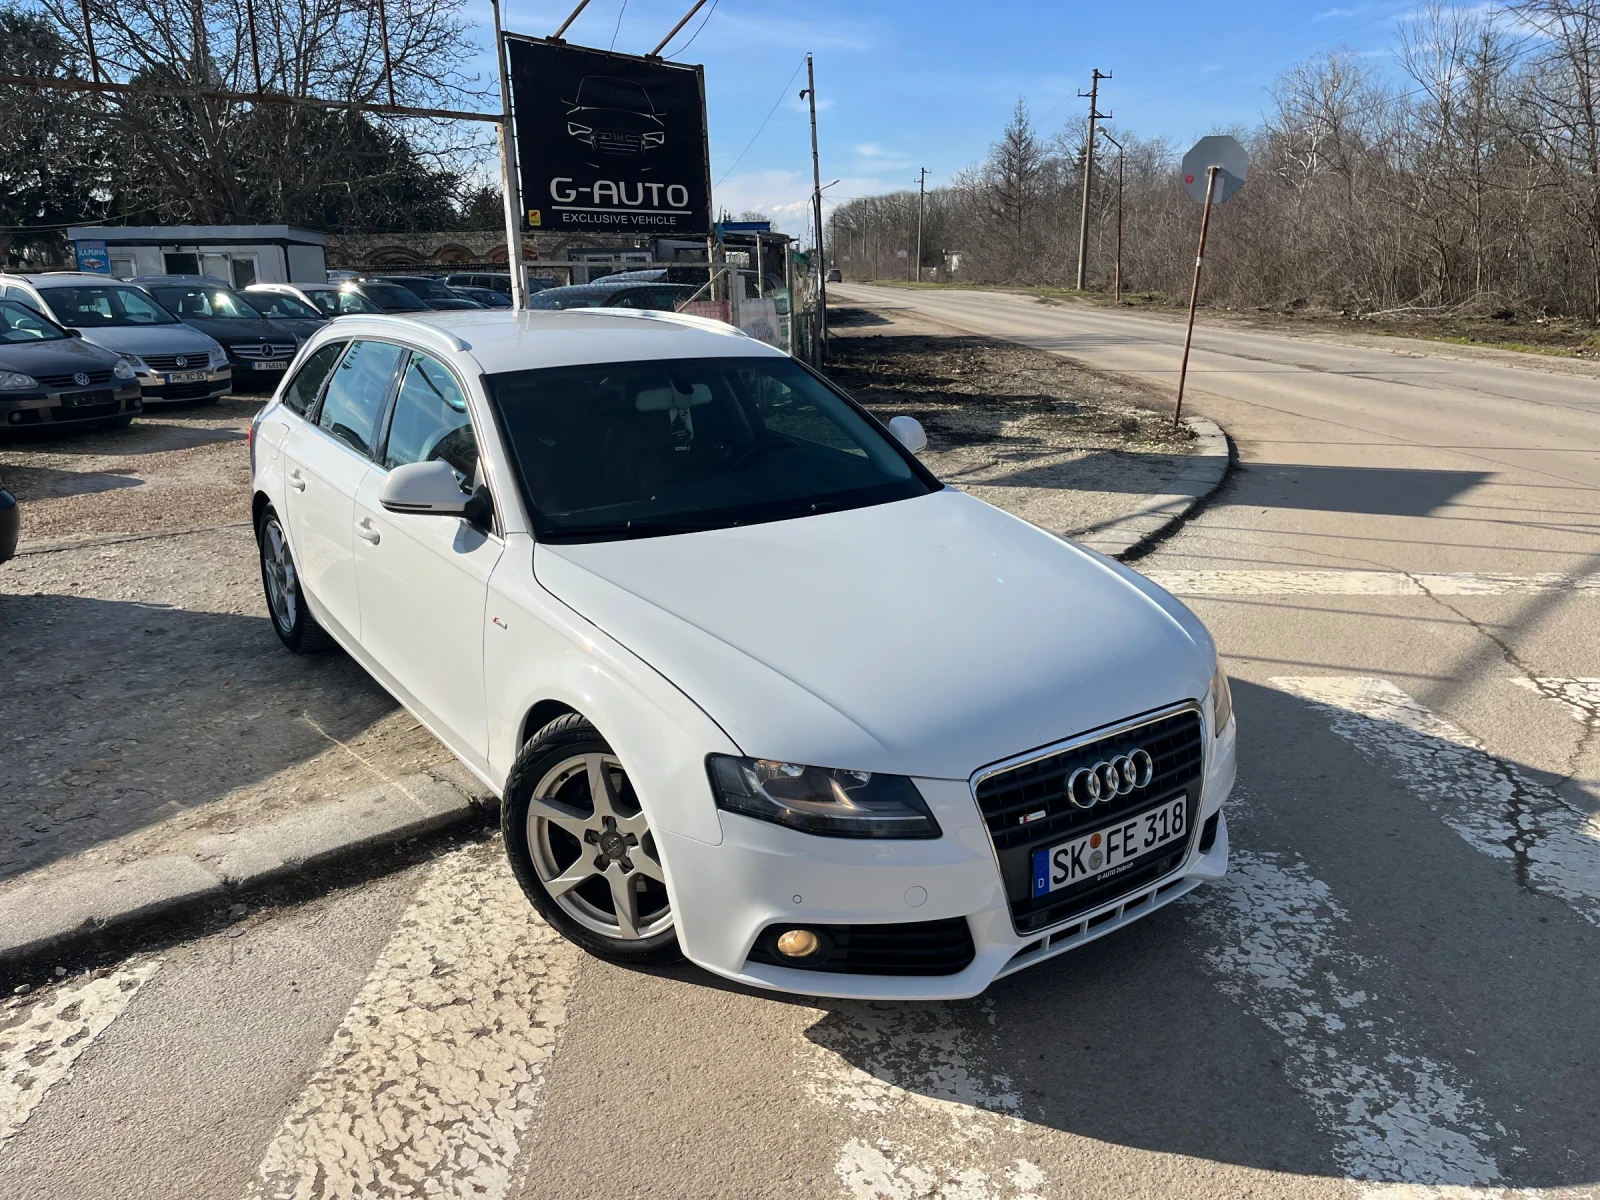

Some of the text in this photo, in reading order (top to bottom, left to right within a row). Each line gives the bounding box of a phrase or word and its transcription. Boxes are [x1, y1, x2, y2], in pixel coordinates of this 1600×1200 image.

[550, 177, 689, 207] G-AUTO
[562, 213, 677, 225] EXCLUSIVE VEHICLE
[1052, 801, 1184, 885] SK FE 318
[1038, 878, 1045, 888] D
